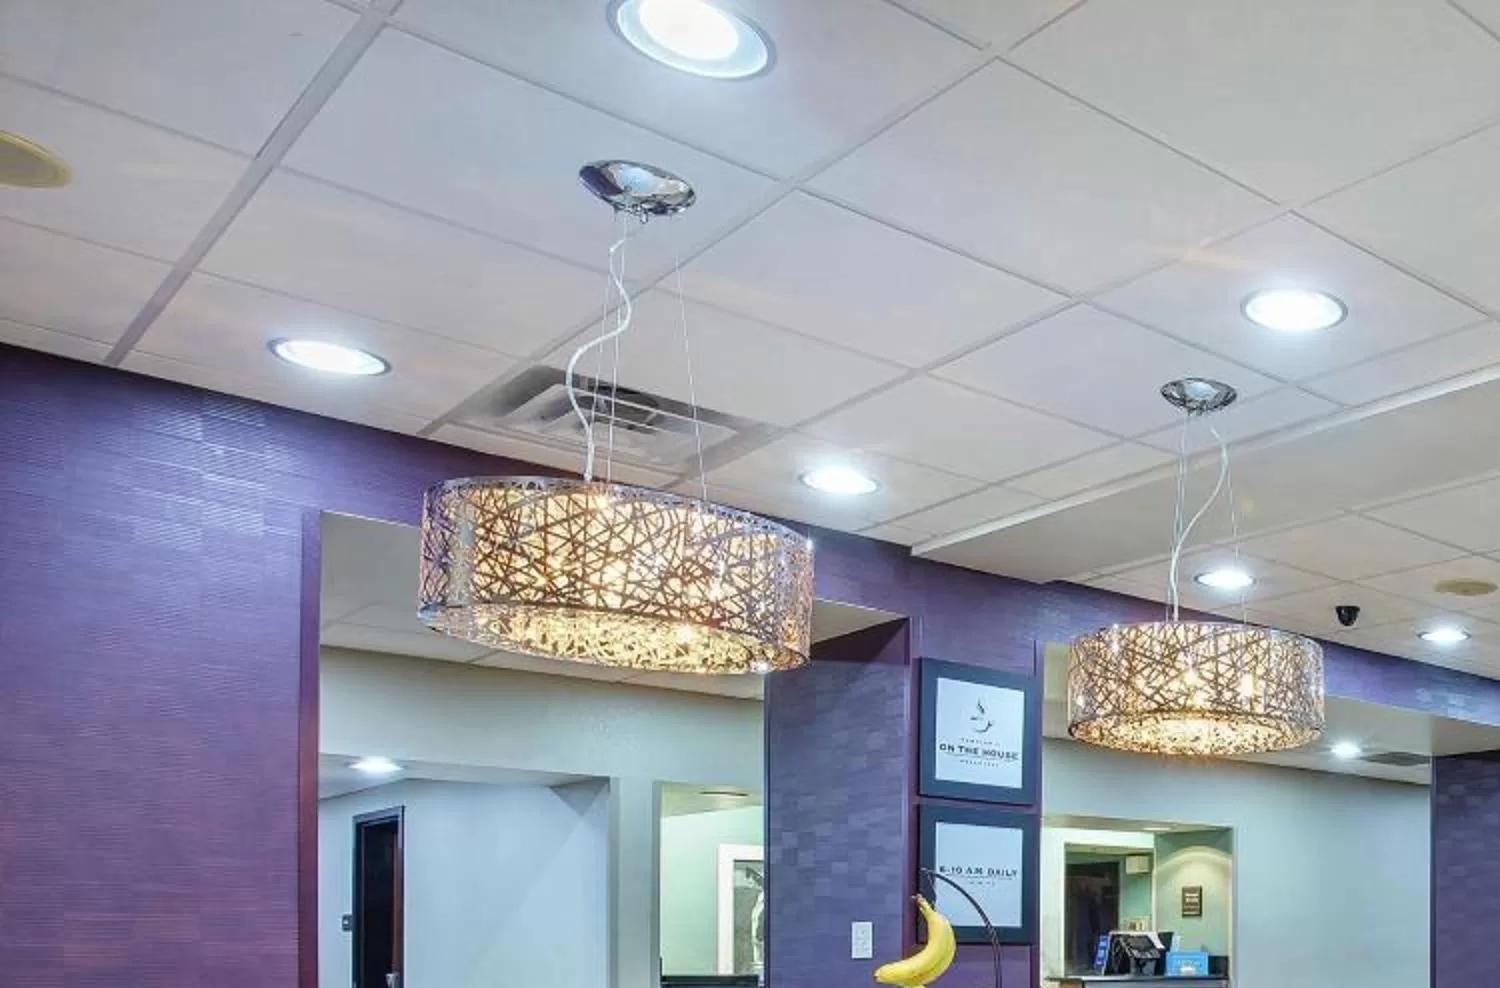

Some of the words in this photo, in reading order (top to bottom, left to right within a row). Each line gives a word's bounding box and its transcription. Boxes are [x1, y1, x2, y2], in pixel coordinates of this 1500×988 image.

[939, 743, 955, 753] ON
[957, 745, 979, 755] THE
[983, 749, 1019, 760] HOUSE
[965, 867, 983, 875] AM
[987, 867, 1017, 877] DAILY
